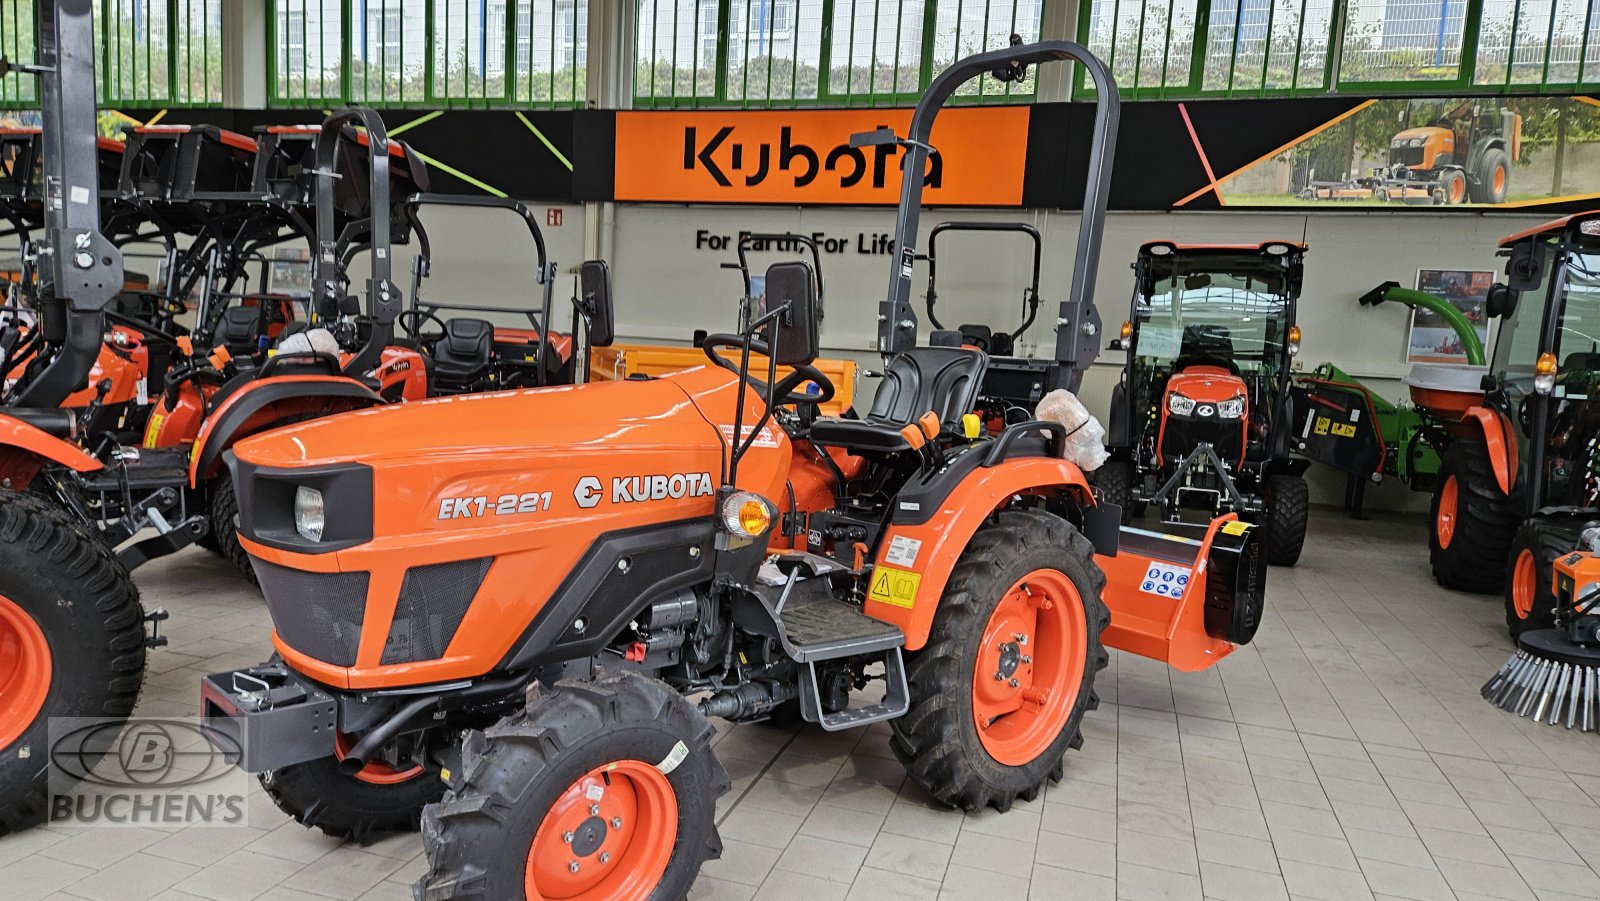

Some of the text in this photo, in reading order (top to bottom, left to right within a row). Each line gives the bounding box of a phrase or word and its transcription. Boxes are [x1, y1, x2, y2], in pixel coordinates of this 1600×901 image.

[683, 125, 943, 189] Kubota
[696, 230, 731, 250] For
[811, 232, 849, 253] For
[612, 472, 714, 503] KUBOTA
[437, 491, 553, 520] EK1-221
